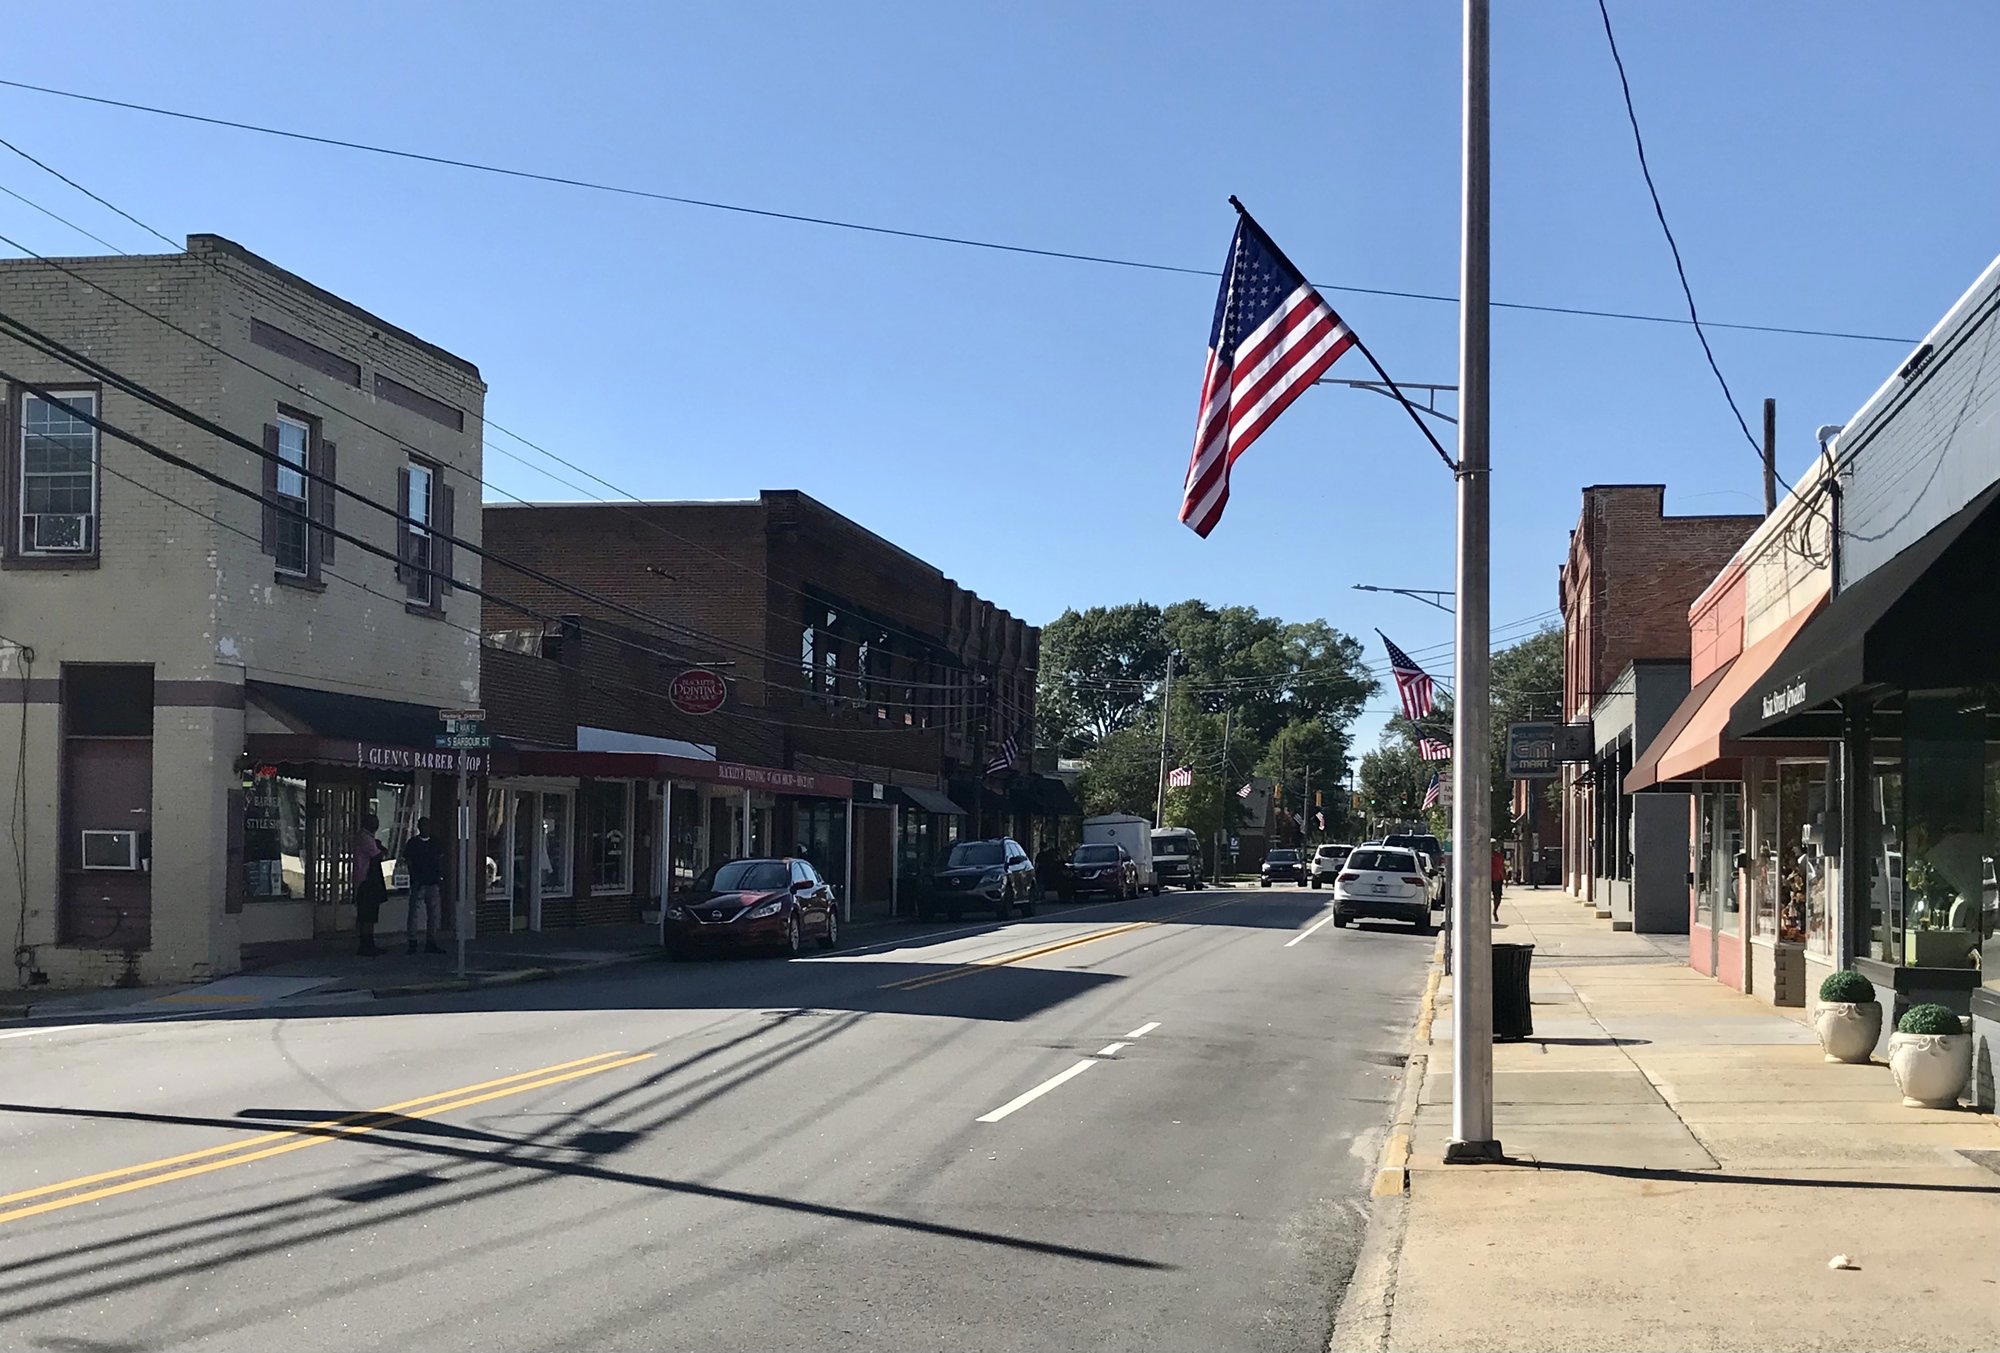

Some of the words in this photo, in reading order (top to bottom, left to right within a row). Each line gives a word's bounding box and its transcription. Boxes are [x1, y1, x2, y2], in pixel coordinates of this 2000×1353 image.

[674, 683, 723, 696] PRINTING
[446, 736, 452, 747] S
[452, 736, 481, 747] BARBOUR
[481, 736, 490, 747] ST
[369, 747, 409, 767] GLEN'S
[414, 752, 454, 770] BARBER
